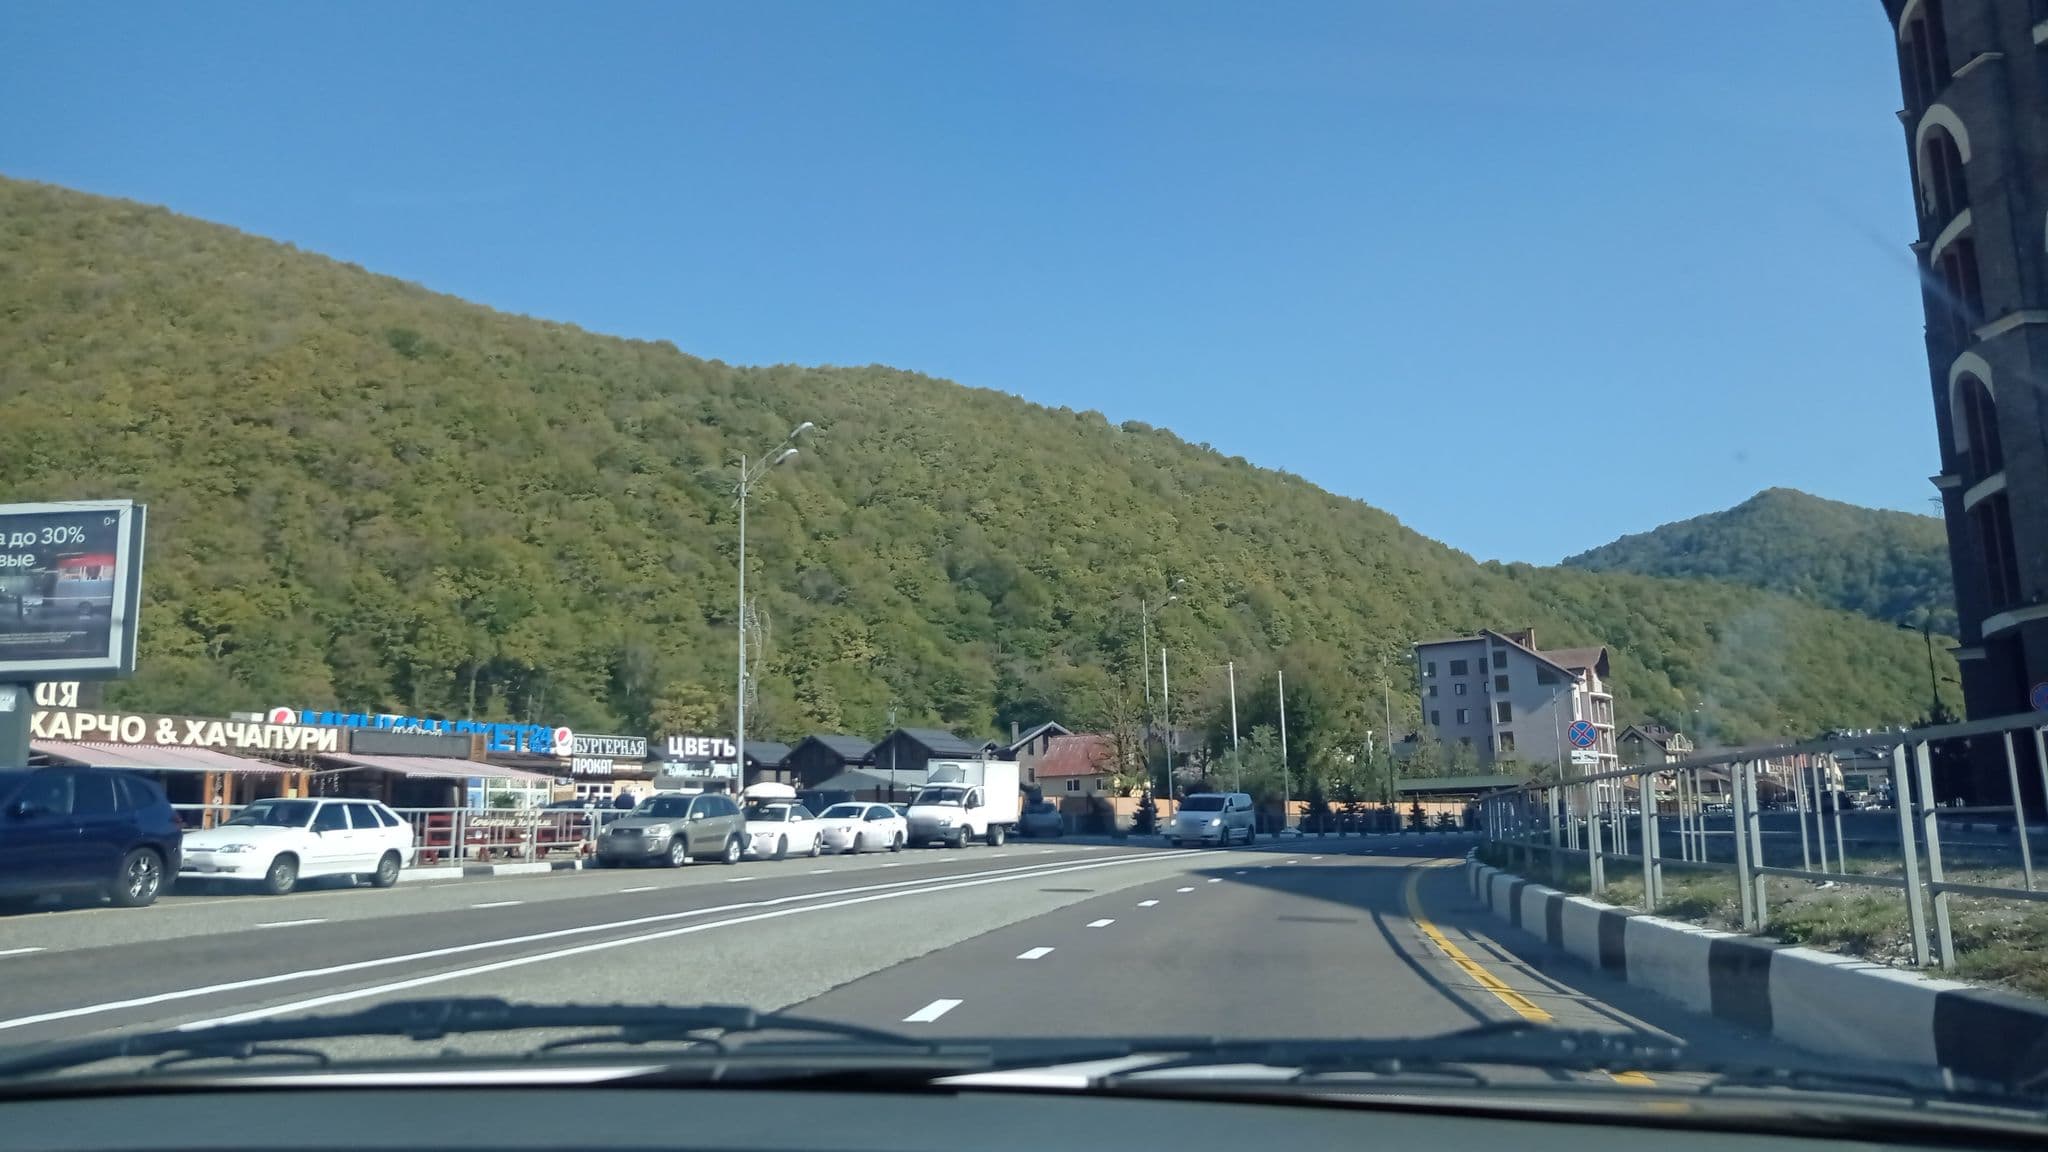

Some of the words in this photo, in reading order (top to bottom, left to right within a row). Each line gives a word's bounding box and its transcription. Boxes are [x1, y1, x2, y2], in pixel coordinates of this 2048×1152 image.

[8, 532, 37, 549] до
[41, 526, 85, 545] 30%
[155, 719, 178, 745] &
[182, 720, 338, 753] ХАЧАПУРИ
[575, 737, 645, 755] БУРГЕРНАЯ
[572, 758, 613, 775] ПРОКАТ
